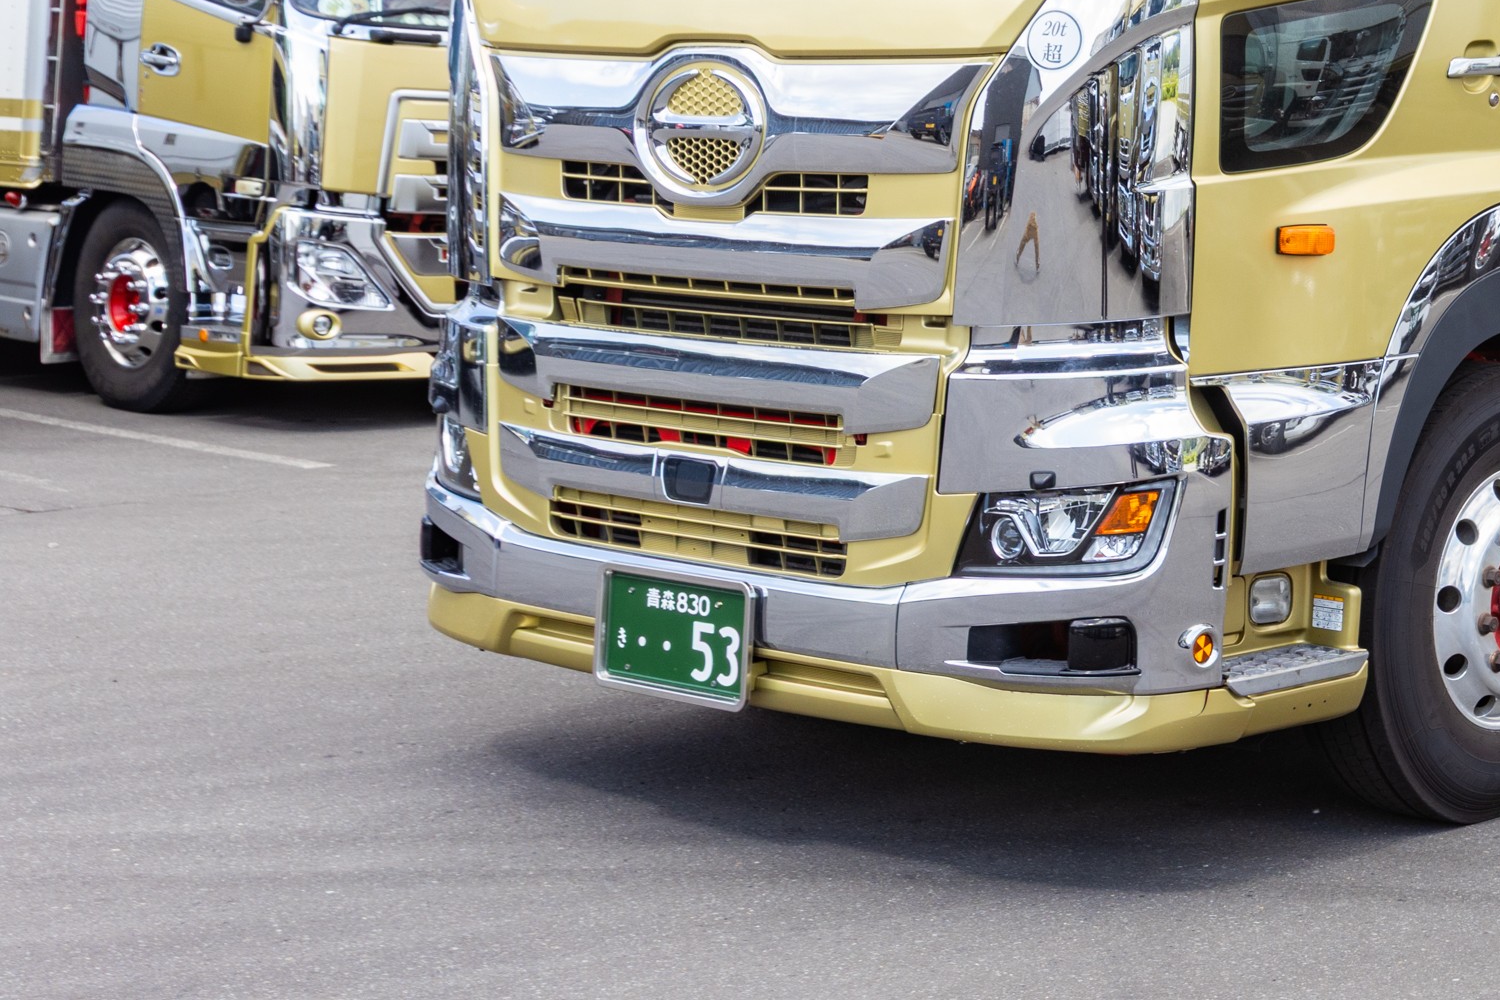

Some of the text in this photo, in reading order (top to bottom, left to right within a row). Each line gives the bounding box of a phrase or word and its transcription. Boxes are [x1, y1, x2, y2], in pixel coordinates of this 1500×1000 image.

[1042, 20, 1068, 37] 20t
[1042, 42, 1063, 64] 超
[690, 621, 740, 686] 53
